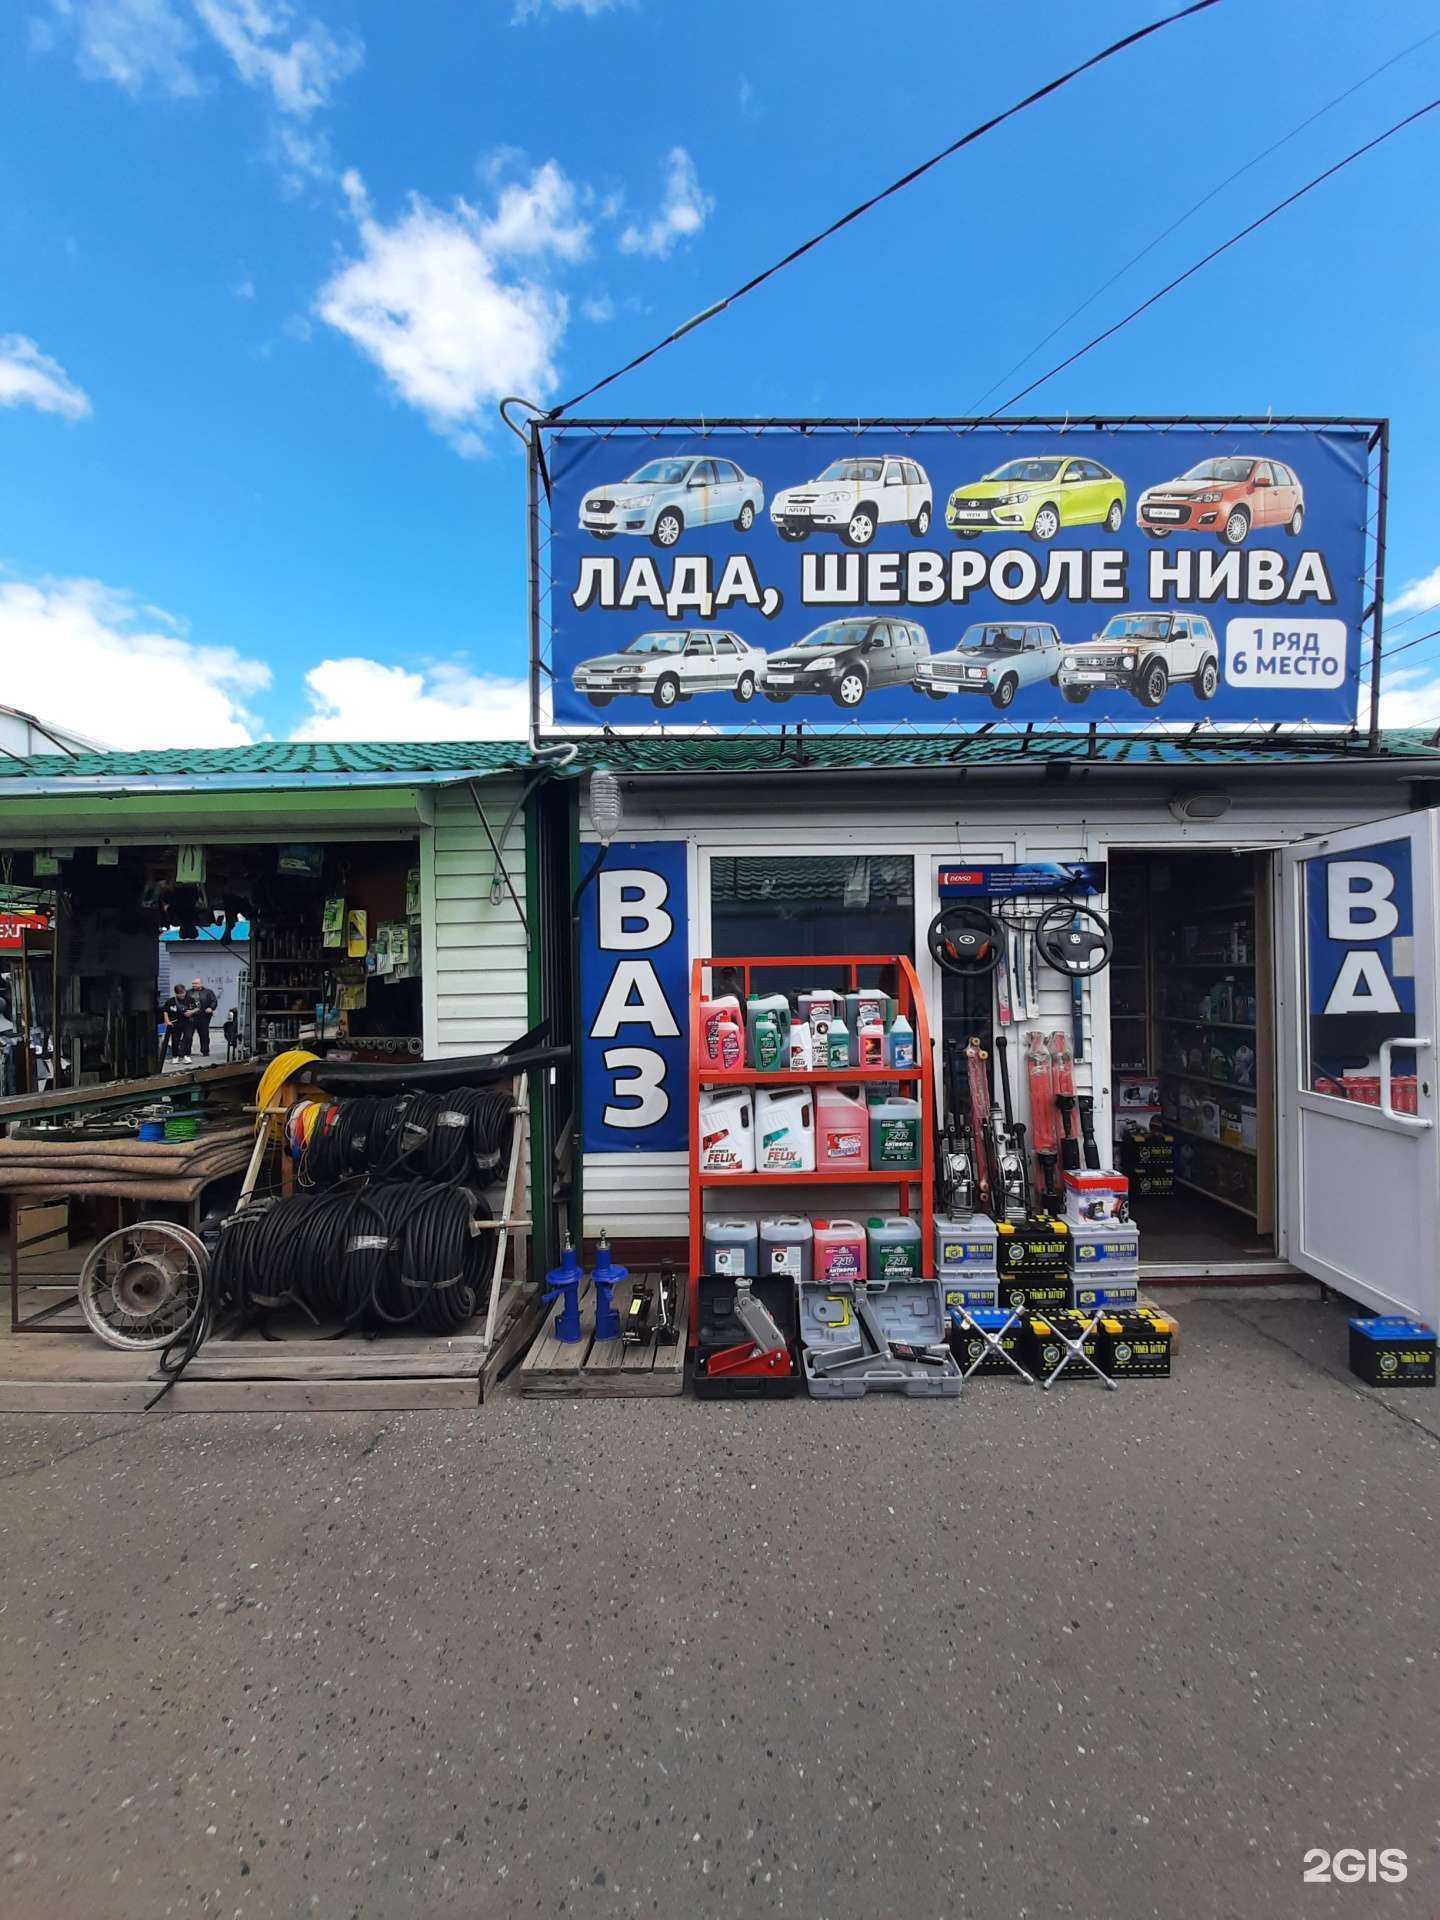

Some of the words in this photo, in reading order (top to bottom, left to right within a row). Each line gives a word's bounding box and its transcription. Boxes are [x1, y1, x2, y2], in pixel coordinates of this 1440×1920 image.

[572, 555, 779, 617] ЛАДА,
[802, 550, 1124, 602] ШЕВРОЛЕ
[1149, 549, 1332, 601] НИВА
[1252, 628, 1264, 651] 1
[1272, 631, 1320, 656] РЯД
[1232, 650, 1248, 676] 6
[1255, 655, 1339, 677] МЕСТО
[949, 874, 972, 883] DENSO
[589, 868, 682, 1130] ВАЗ
[708, 1153, 737, 1163] FELIX
[767, 1151, 797, 1161] FELIX
